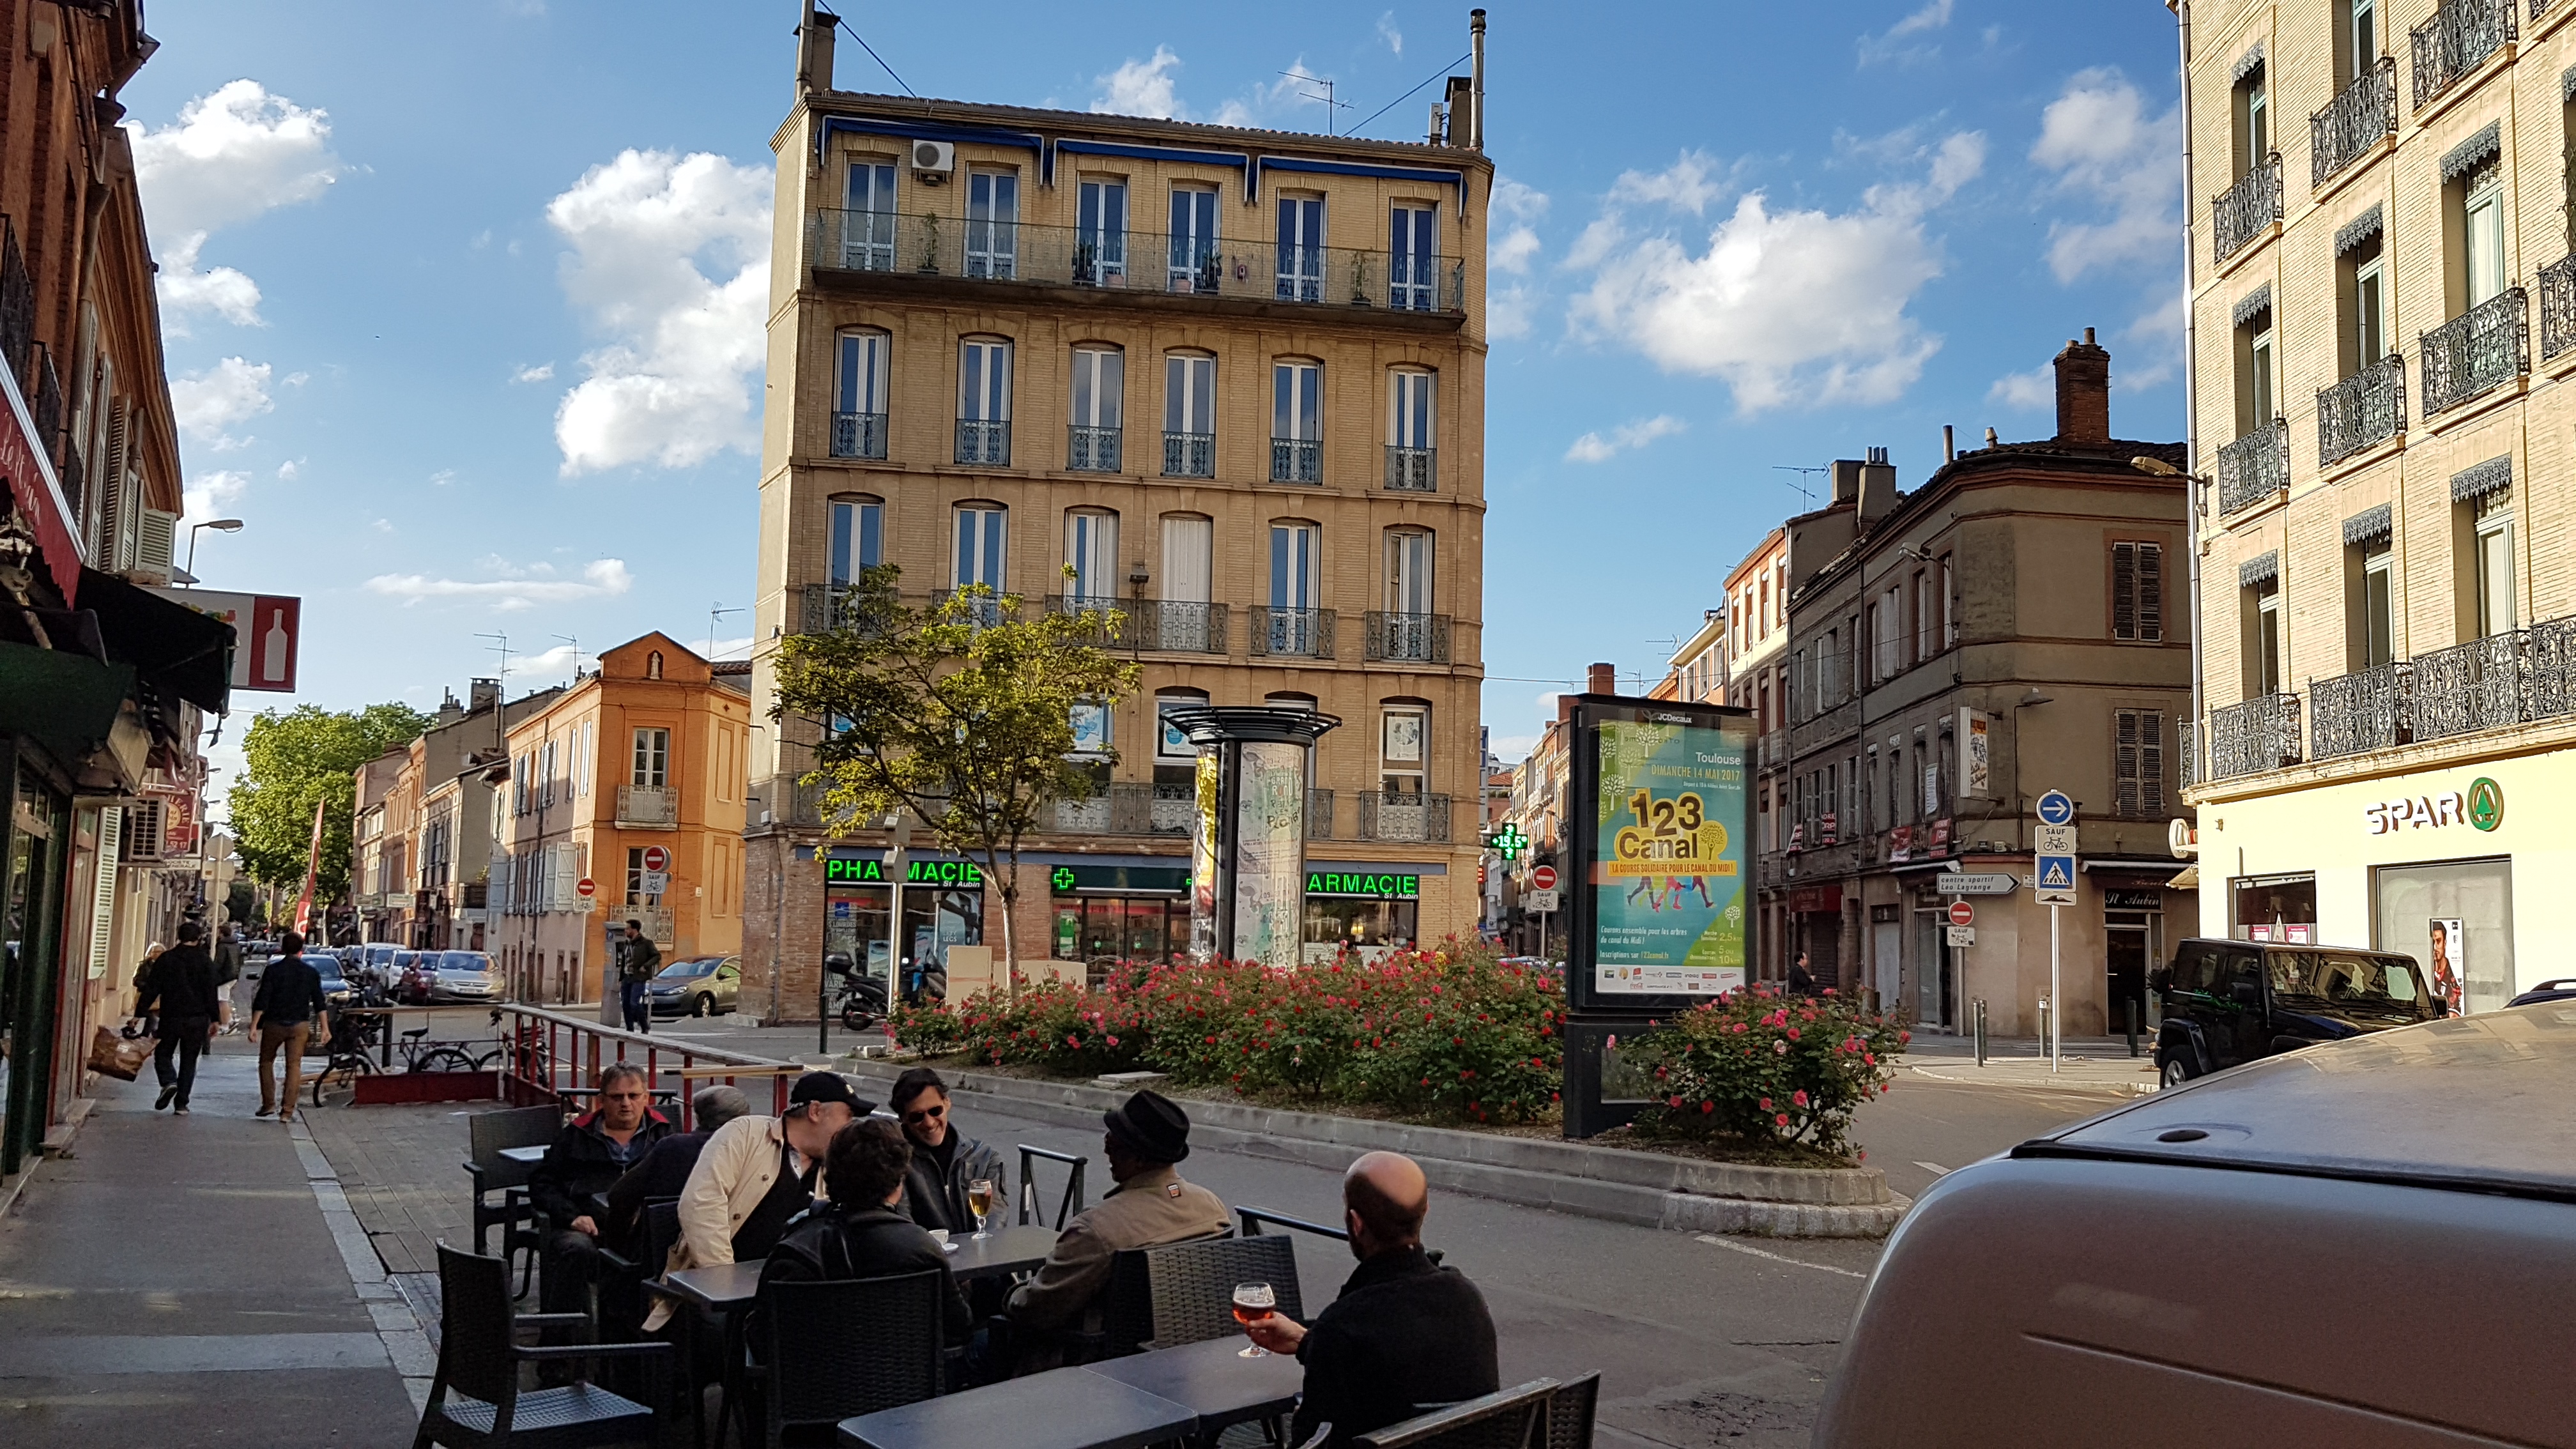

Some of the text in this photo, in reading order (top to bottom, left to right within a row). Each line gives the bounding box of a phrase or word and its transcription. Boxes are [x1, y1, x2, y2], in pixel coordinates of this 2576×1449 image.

[1658, 713, 1692, 723] JCDecaux
[1695, 752, 1741, 765] Toulouse
[1652, 764, 1740, 781] DIMANCHE 14 MAI 2017
[2366, 792, 2464, 834] SPAR
[1619, 832, 1698, 859] Canal
[828, 860, 981, 882] PHAMACIE
[1612, 863, 1619, 873] LA
[1620, 863, 1640, 873] COURSE
[1641, 863, 1668, 873] SOLIDAIRE
[1669, 863, 1683, 873] POUR
[1684, 863, 1690, 873] LE
[1691, 863, 1708, 873] CANAL
[1709, 863, 1716, 873] DU
[1717, 863, 1730, 873] MIDI
[1307, 873, 1416, 894] ARMACIE
[2125, 894, 2159, 905] Aubin
